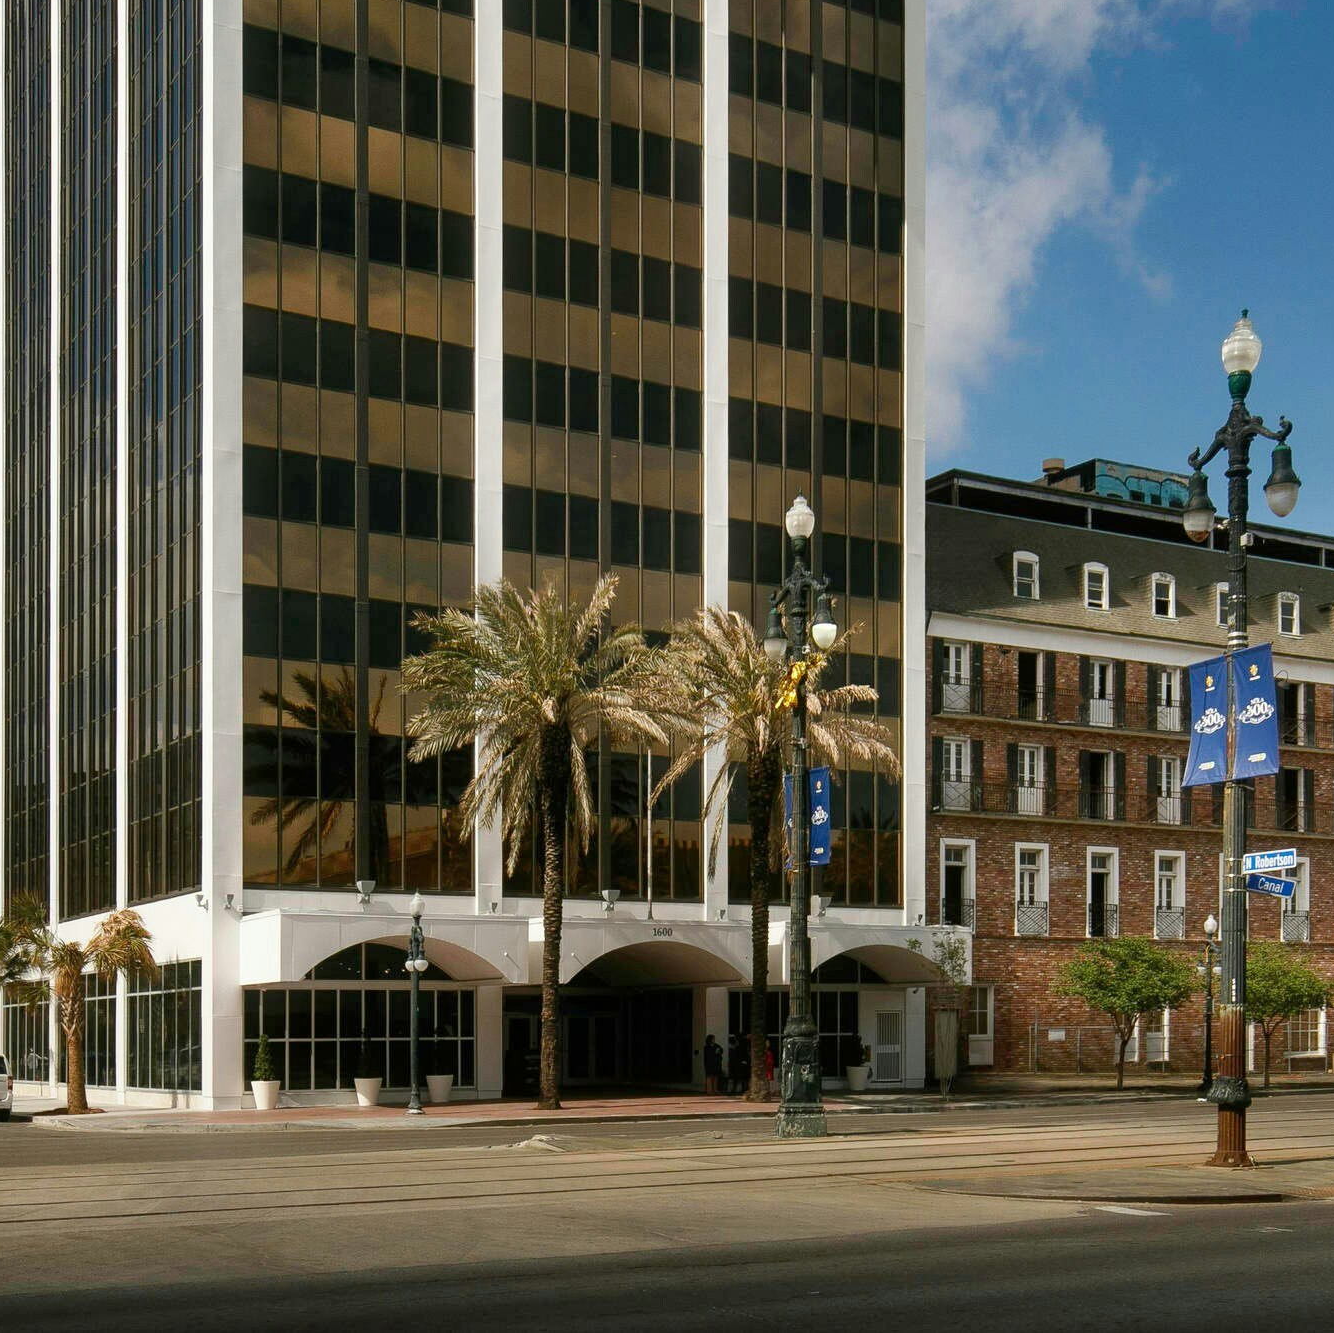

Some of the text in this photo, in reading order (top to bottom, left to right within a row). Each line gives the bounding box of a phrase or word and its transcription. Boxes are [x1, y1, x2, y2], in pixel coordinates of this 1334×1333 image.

[1247, 702, 1268, 717] 300
[1246, 854, 1294, 870] N Robertson
[1258, 878, 1284, 893] Canal
[653, 927, 673, 937] 1600
